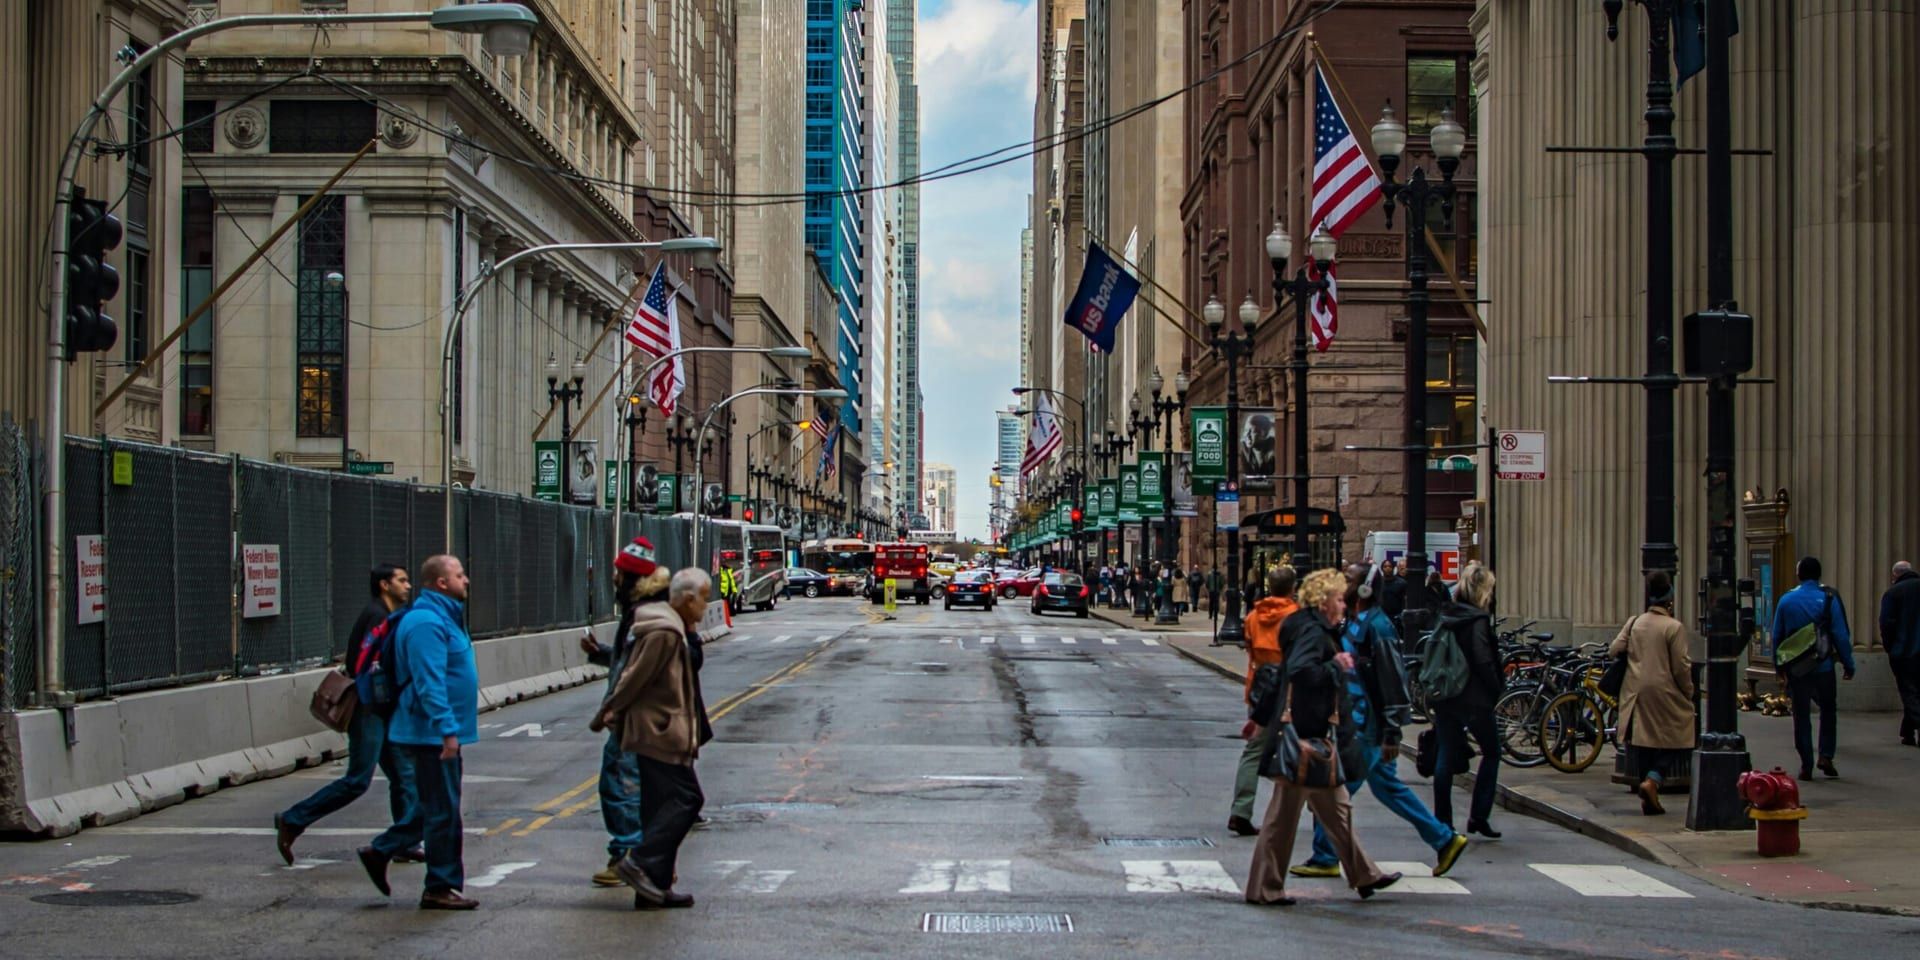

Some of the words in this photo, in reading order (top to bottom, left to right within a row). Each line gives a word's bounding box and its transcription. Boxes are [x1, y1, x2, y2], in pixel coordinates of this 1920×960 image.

[1198, 452, 1221, 460] FOOD
[1501, 472, 1517, 480] TOW
[1521, 472, 1541, 480] ZONE
[245, 549, 264, 564] Federal
[253, 584, 276, 597] Entrance
